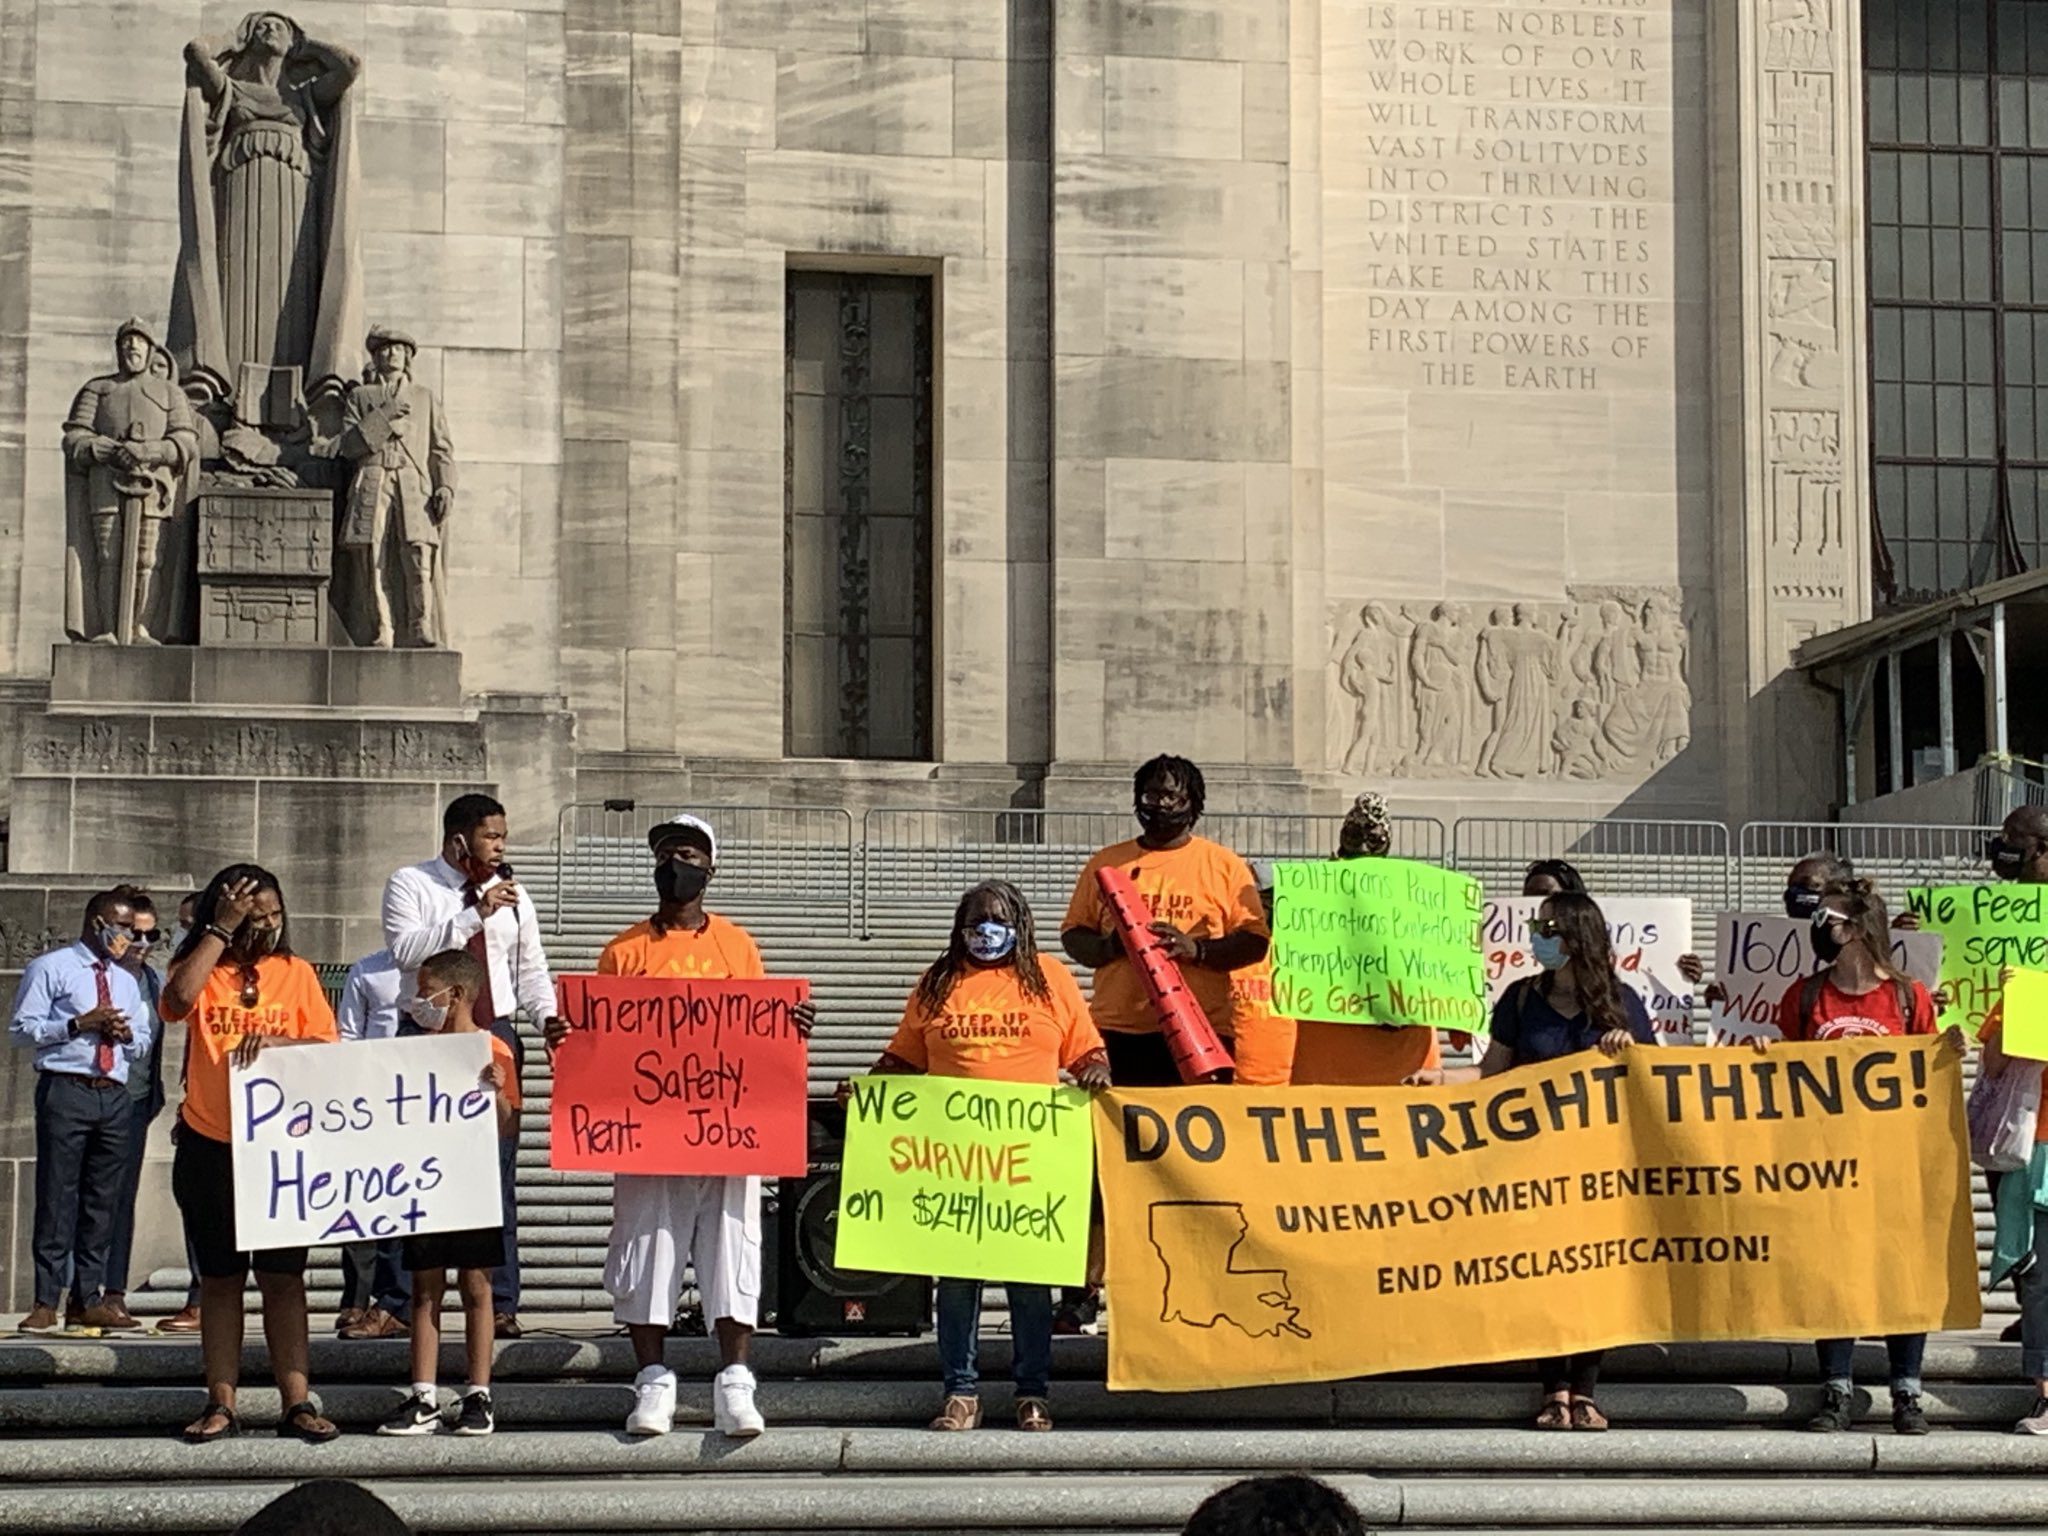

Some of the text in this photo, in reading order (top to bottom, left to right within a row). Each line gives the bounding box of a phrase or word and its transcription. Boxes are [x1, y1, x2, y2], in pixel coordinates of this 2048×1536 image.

[1368, 7, 1646, 39] IS THE NOBLEST
[1368, 39, 1646, 71] WORK OF OVR
[1369, 71, 1647, 102] WHOLE LIVES IT
[1368, 103, 1646, 134] WILL TRANSFORM
[1368, 135, 1648, 166] VAST SOLITVDES
[1368, 167, 1647, 199] INTO THRIVING
[1369, 200, 1648, 230] DISTRICTS THE
[1369, 232, 1649, 262] VNITED STATES
[1369, 264, 1649, 295] TAKE RANK THIS
[1369, 297, 1649, 327] DAY AMONG THE
[1369, 329, 1648, 359] FIRST POWERS OF
[1422, 362, 1597, 389] THE EARTH
[1170, 894, 1193, 909] UP
[1406, 869, 1446, 910] Paid
[1907, 887, 1956, 924] We
[1275, 896, 1390, 940] Corporations
[1272, 942, 1388, 985] Unemployed
[1327, 980, 1380, 1015] Get
[205, 1006, 289, 1026] STEP UP
[944, 1012, 1028, 1028] STEP UP
[940, 1026, 1031, 1040] LOUISIANA
[634, 1050, 748, 1108] Safety.
[244, 1072, 490, 1142] Pass the
[853, 1080, 1072, 1136] We cannot
[1123, 1050, 1928, 1163] DO THE RIGHT THING!
[570, 1103, 760, 1155] Rent. Jobs.
[889, 1135, 1032, 1187] SURVIVE
[268, 1149, 442, 1221] Heroes
[1276, 1158, 1859, 1233] UNEMPLOYMENT BENEFITS NOW!
[319, 1198, 427, 1240] Act
[846, 1188, 883, 1222] on
[1377, 1235, 1770, 1295] END MISCLASSIFICATION!
